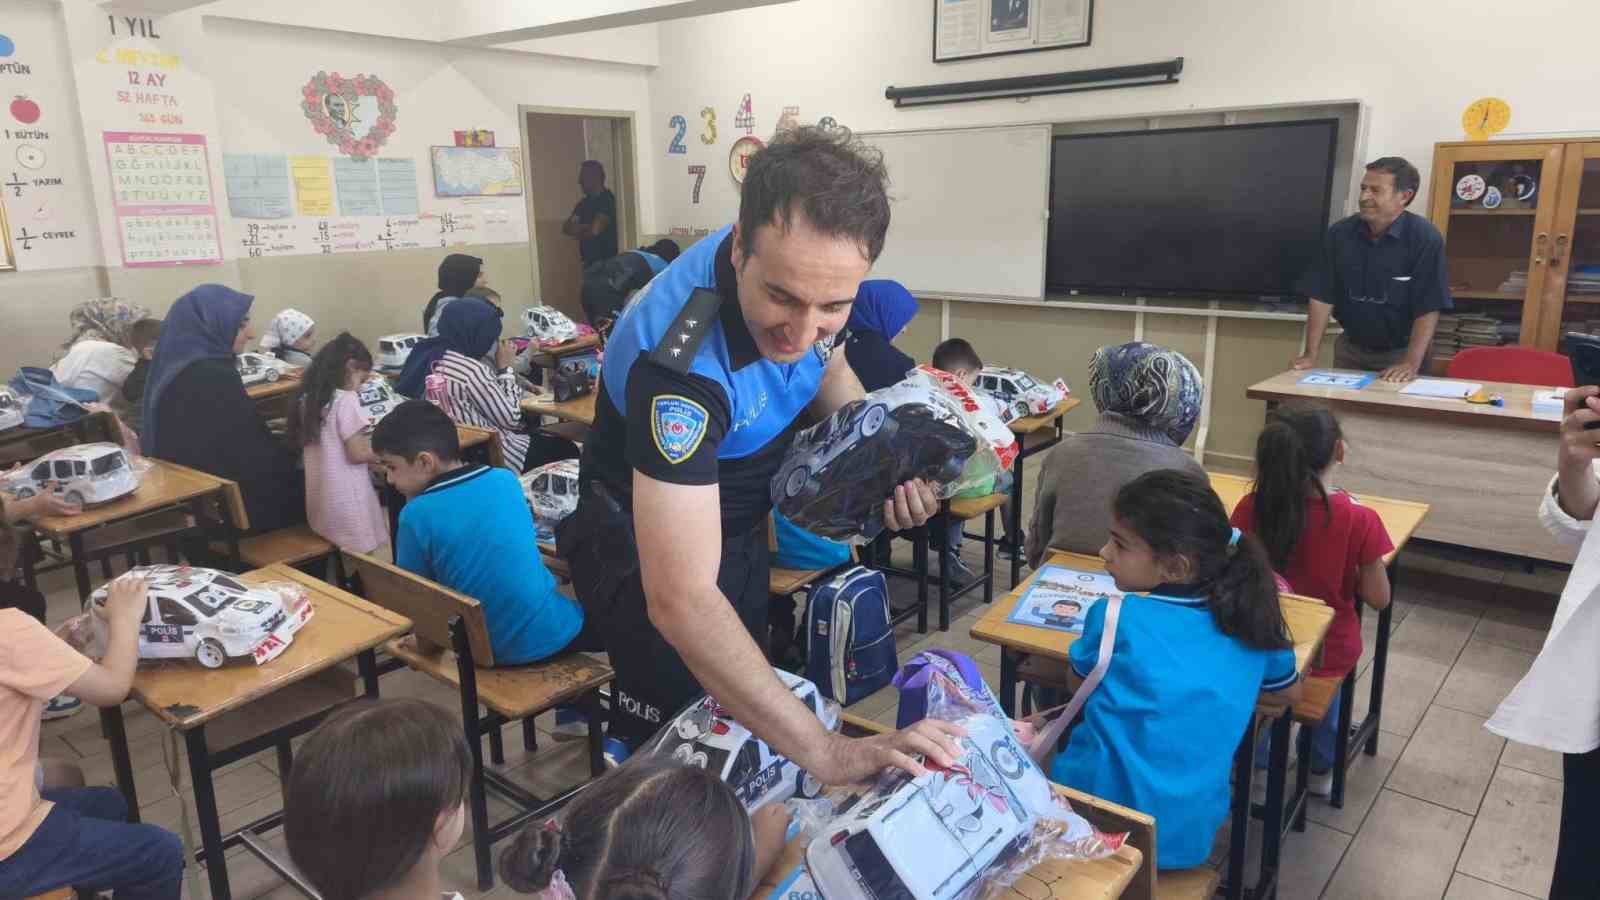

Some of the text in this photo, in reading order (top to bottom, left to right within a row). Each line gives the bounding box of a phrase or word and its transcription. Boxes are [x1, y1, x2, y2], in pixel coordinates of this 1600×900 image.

[108, 15, 160, 39] 1 YIL
[146, 73, 167, 87] AY
[700, 106, 718, 145] 3
[735, 93, 755, 135] 4
[669, 115, 687, 154] 2
[687, 165, 706, 204] 7
